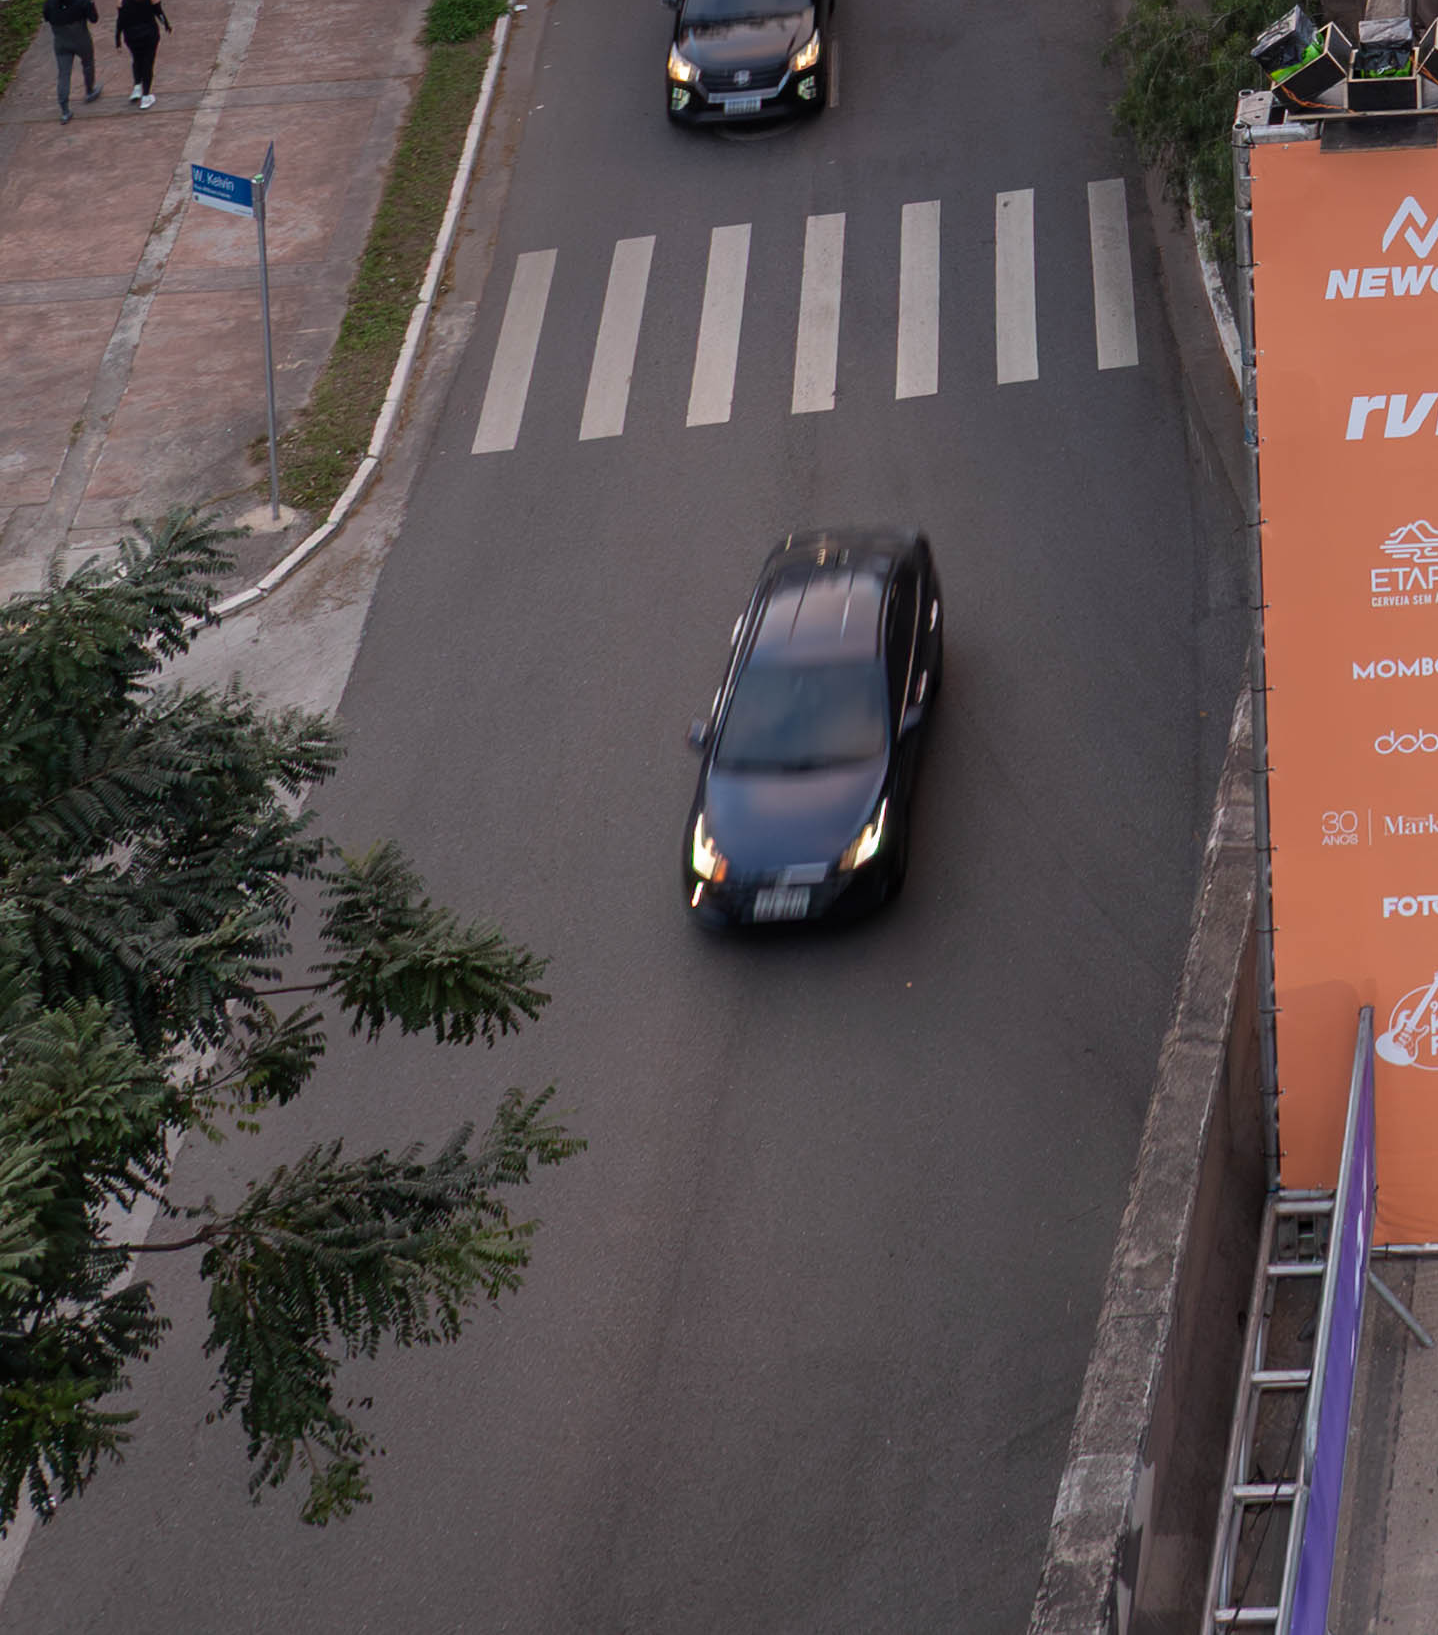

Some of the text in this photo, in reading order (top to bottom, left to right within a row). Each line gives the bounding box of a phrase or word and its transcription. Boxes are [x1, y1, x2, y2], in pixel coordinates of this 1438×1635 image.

[207, 172, 235, 192] Kelvin
[1371, 596, 1410, 608] CERVEJA
[1413, 594, 1432, 606] SEM
[1321, 810, 1358, 834] 30
[1321, 834, 1359, 846] ANOS
